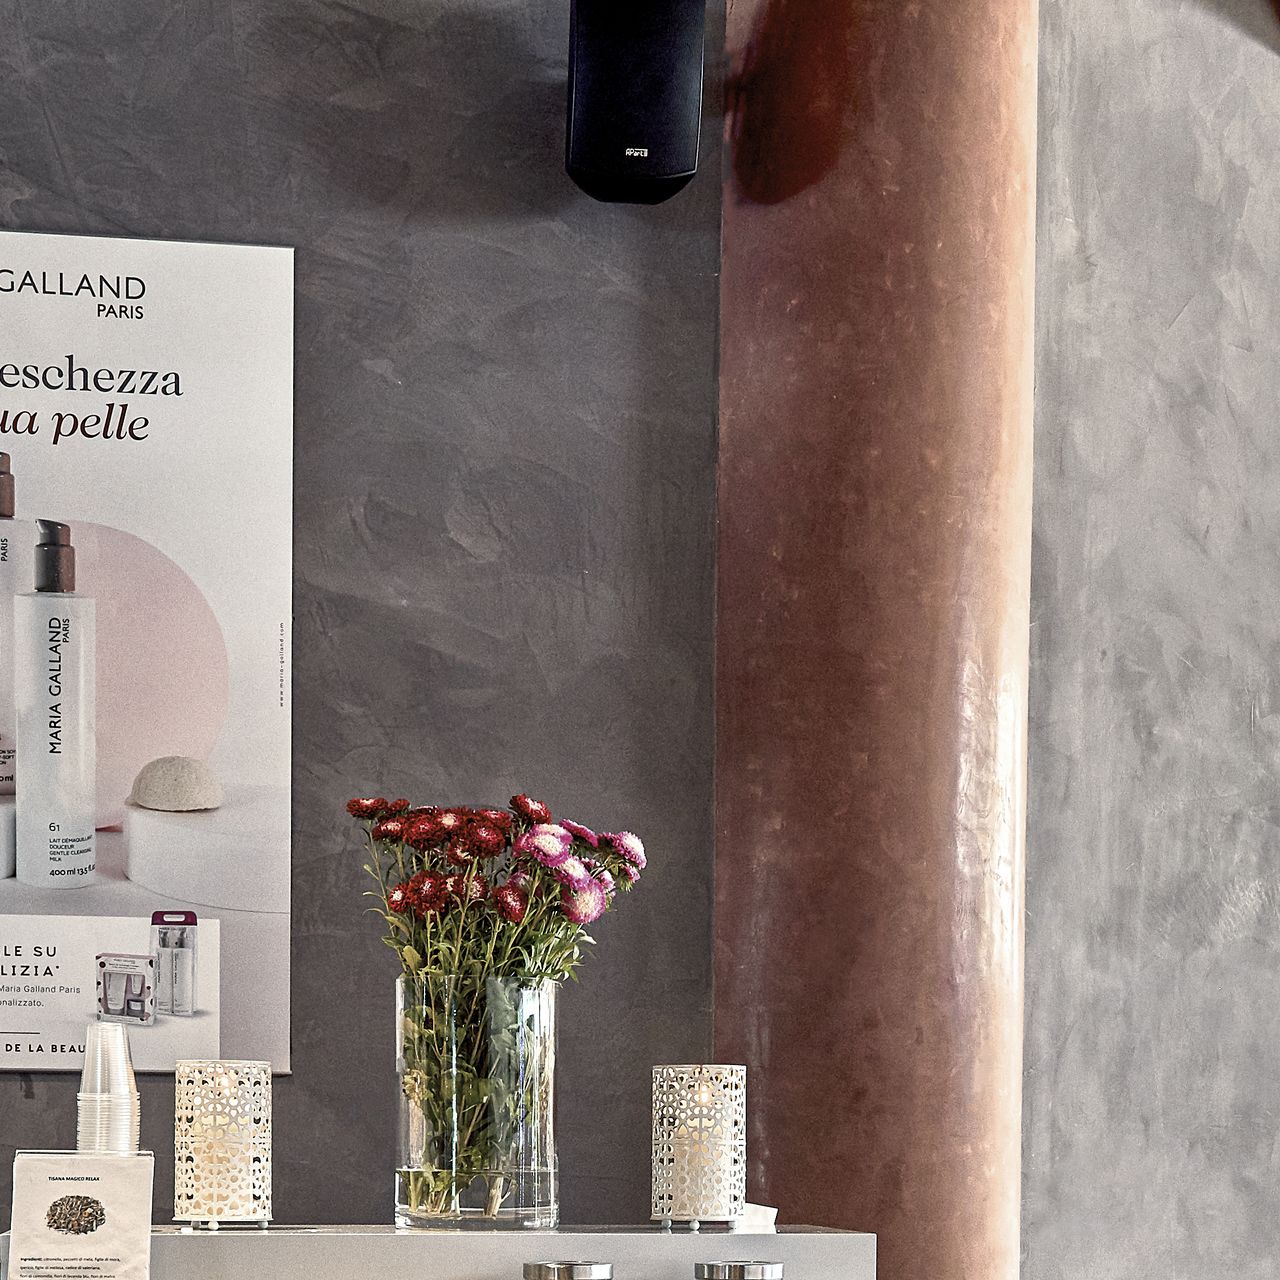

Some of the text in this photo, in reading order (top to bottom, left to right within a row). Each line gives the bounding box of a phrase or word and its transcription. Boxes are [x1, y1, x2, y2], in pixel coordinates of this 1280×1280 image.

[97, 304, 144, 320] PARIS
[51, 403, 150, 445] pelle
[0, 537, 9, 562] PARIS
[62, 618, 70, 643] PARIS
[48, 616, 62, 754] MARIA GALLAND
[48, 822, 60, 832] 61
[67, 867, 76, 876] ml
[33, 946, 57, 957] SU
[23, 985, 56, 994] Galland
[59, 986, 81, 994] Paris
[5, 1043, 21, 1052] DE
[28, 1044, 44, 1053] LA
[51, 1044, 85, 1053] BEAU
